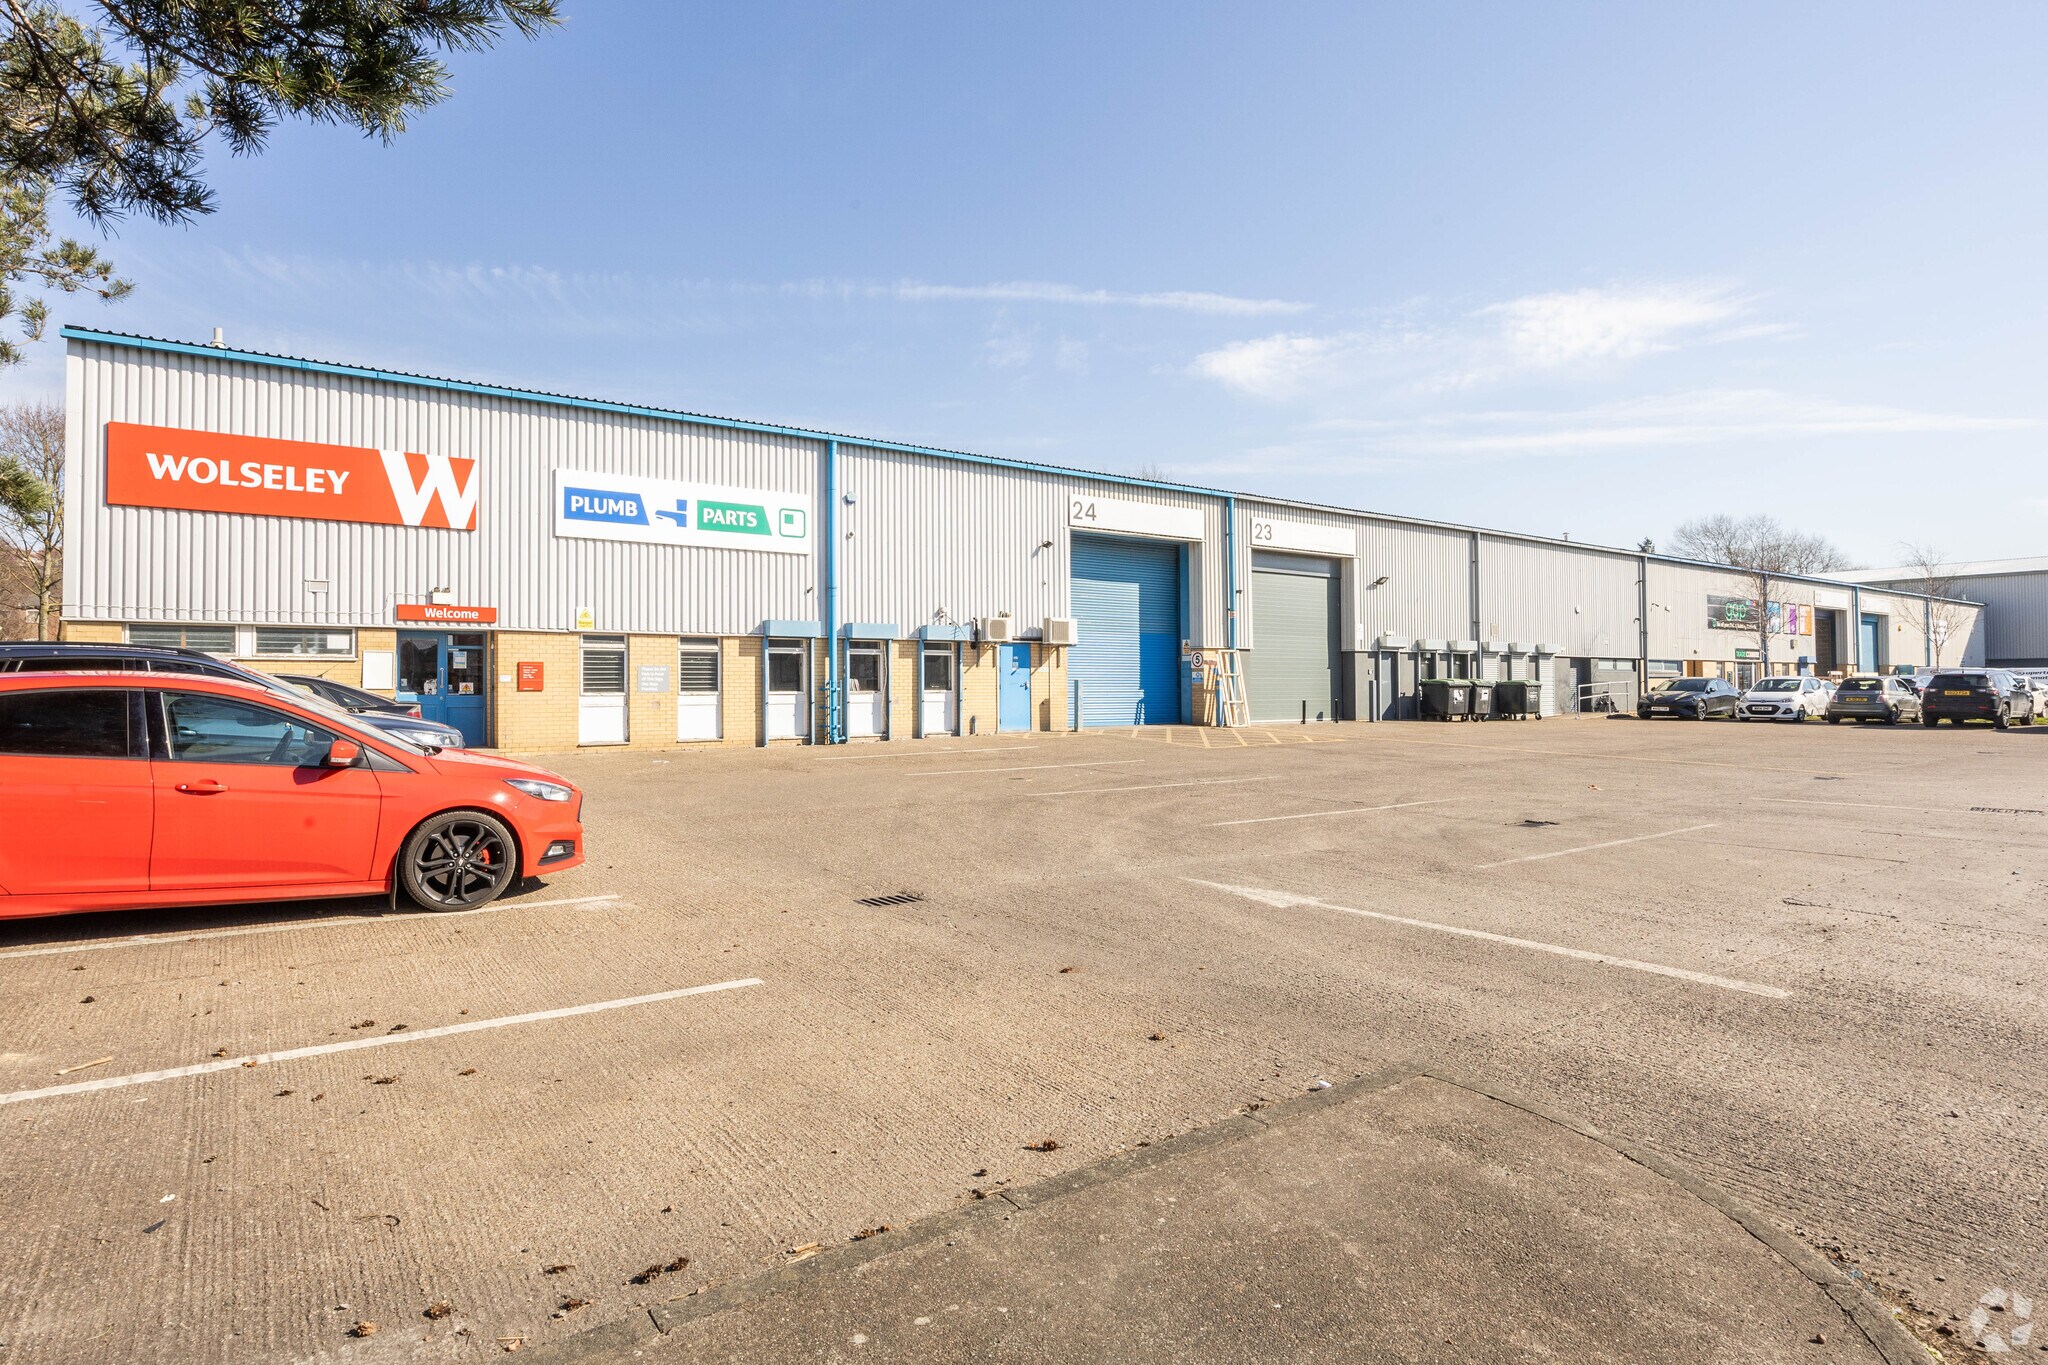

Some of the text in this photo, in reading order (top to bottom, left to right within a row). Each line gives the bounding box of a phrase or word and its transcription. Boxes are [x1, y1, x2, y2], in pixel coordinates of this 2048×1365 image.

[146, 453, 350, 494] WOLSELEY
[379, 449, 477, 530] W
[570, 495, 758, 528] PLUMB PARTS
[1073, 501, 1097, 521] 24
[1255, 523, 1272, 541] 23
[424, 607, 479, 619] Welcome
[1725, 602, 1747, 621] gap
[1195, 655, 1200, 665] 5
